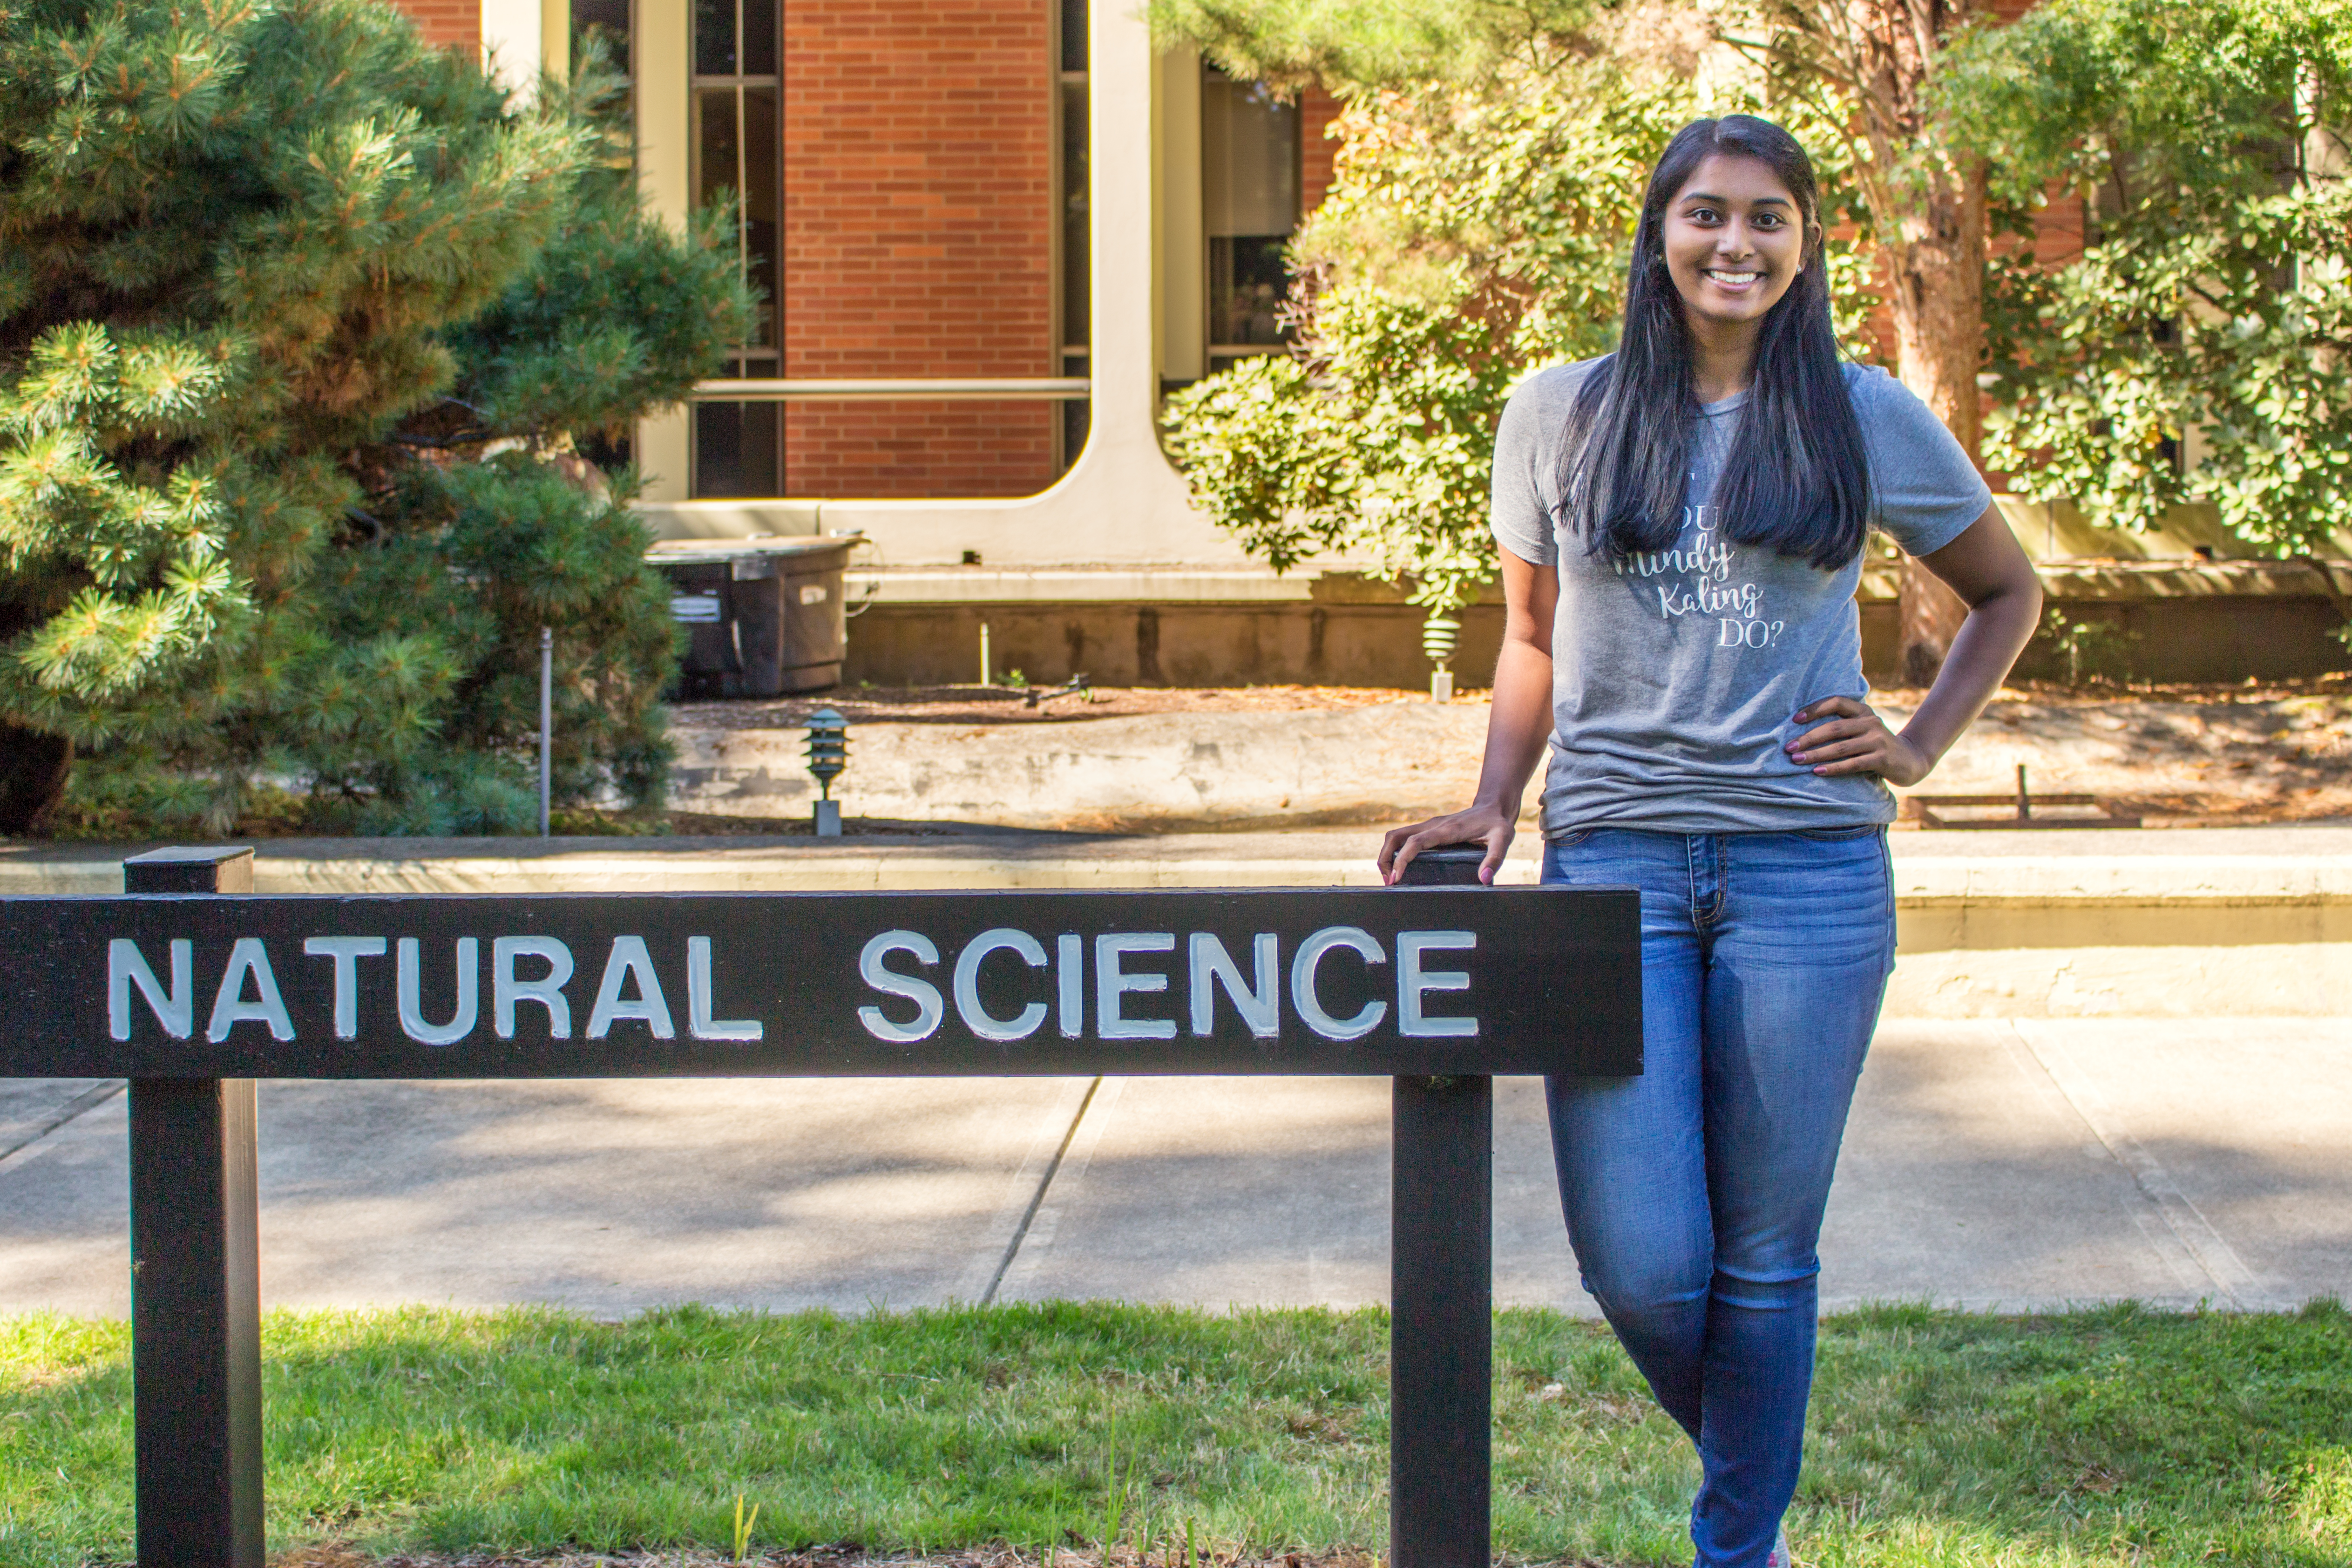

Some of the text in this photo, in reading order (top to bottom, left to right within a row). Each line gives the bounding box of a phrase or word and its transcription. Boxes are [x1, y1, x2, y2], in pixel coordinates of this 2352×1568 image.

[1657, 576, 1763, 619] Kaling
[1717, 618, 1784, 649] DO?
[108, 926, 1479, 1045] NATURAL SCIENCE
